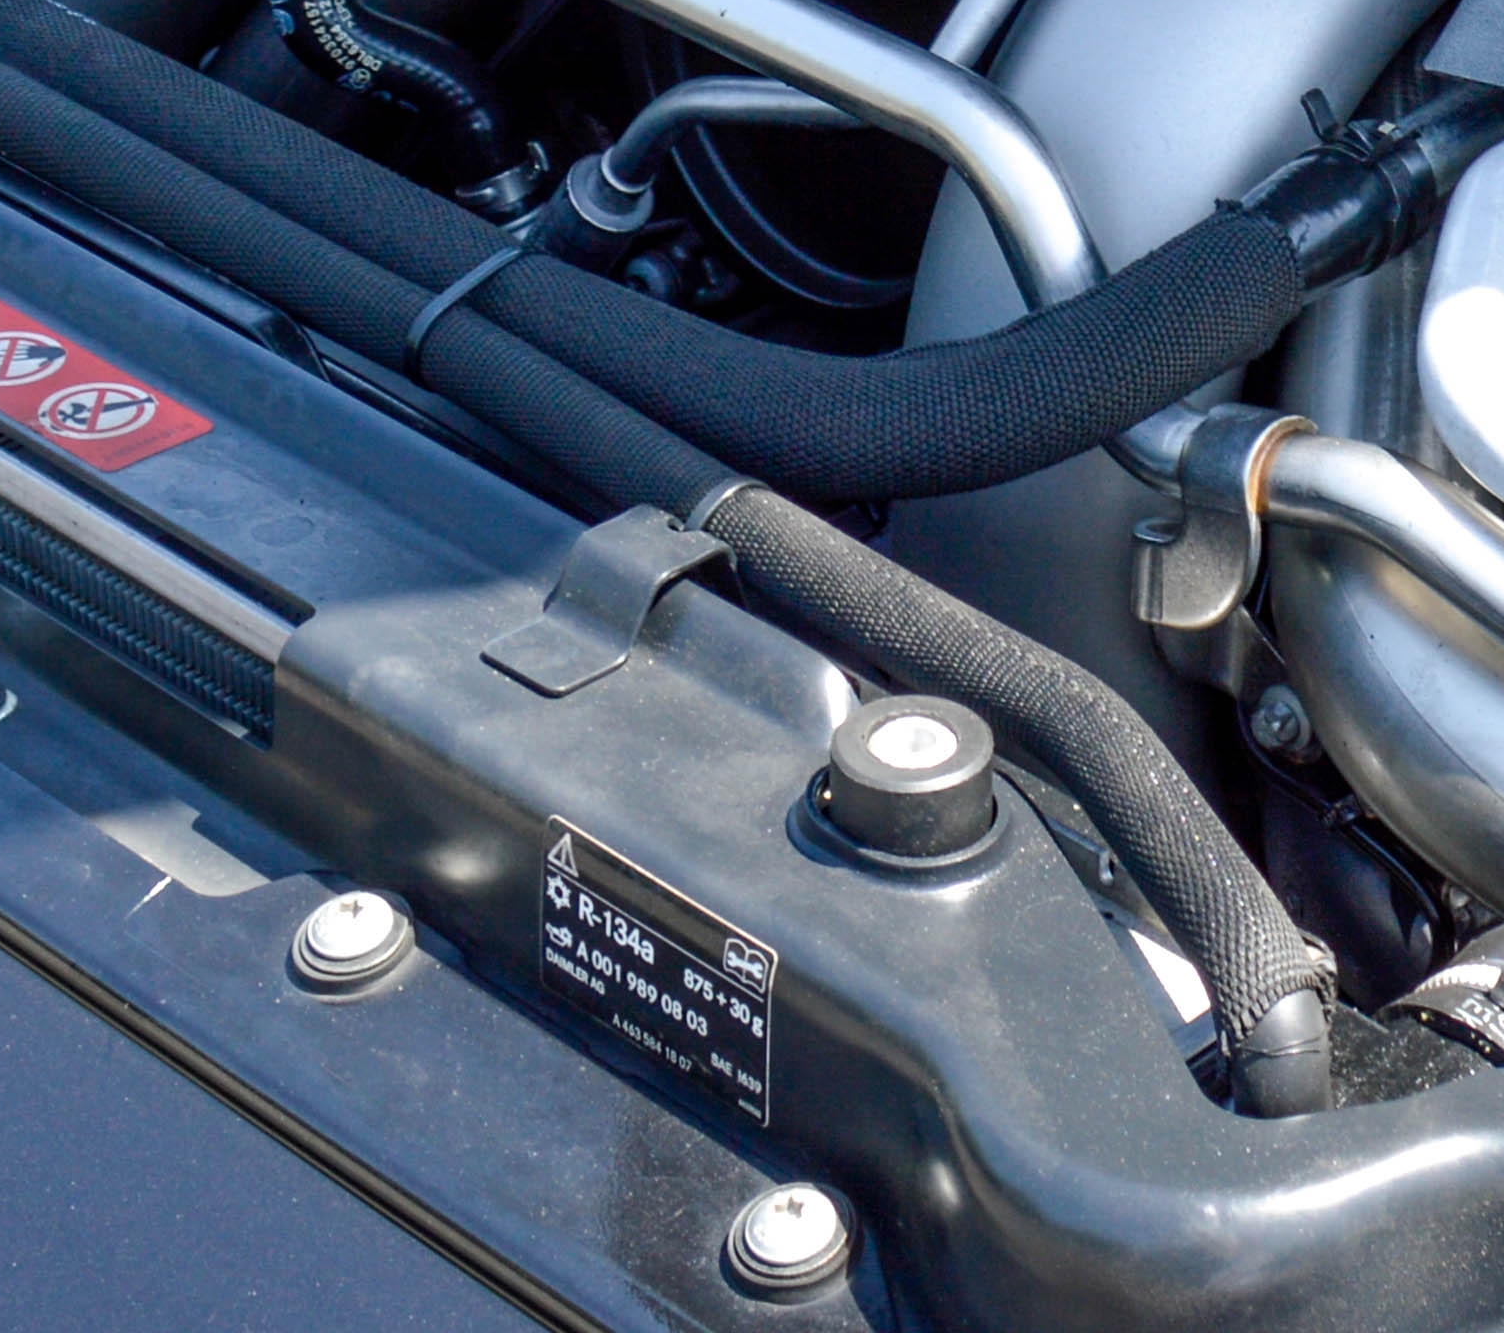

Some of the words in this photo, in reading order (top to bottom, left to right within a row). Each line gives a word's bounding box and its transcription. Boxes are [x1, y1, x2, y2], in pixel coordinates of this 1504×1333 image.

[578, 893, 654, 965] R-134a
[545, 946, 588, 985] DAIMLER
[590, 977, 606, 996] AG
[577, 940, 589, 963] A
[591, 949, 621, 983] 001
[626, 971, 658, 1003] 989
[661, 993, 683, 1022] 08
[686, 1010, 708, 1037] 03
[683, 967, 714, 1002] 875
[729, 997, 750, 1025] 30
[752, 1016, 764, 1038] g
[621, 1020, 642, 1041] 463
[678, 1054, 693, 1072] 07
[710, 1051, 733, 1077] SAE
